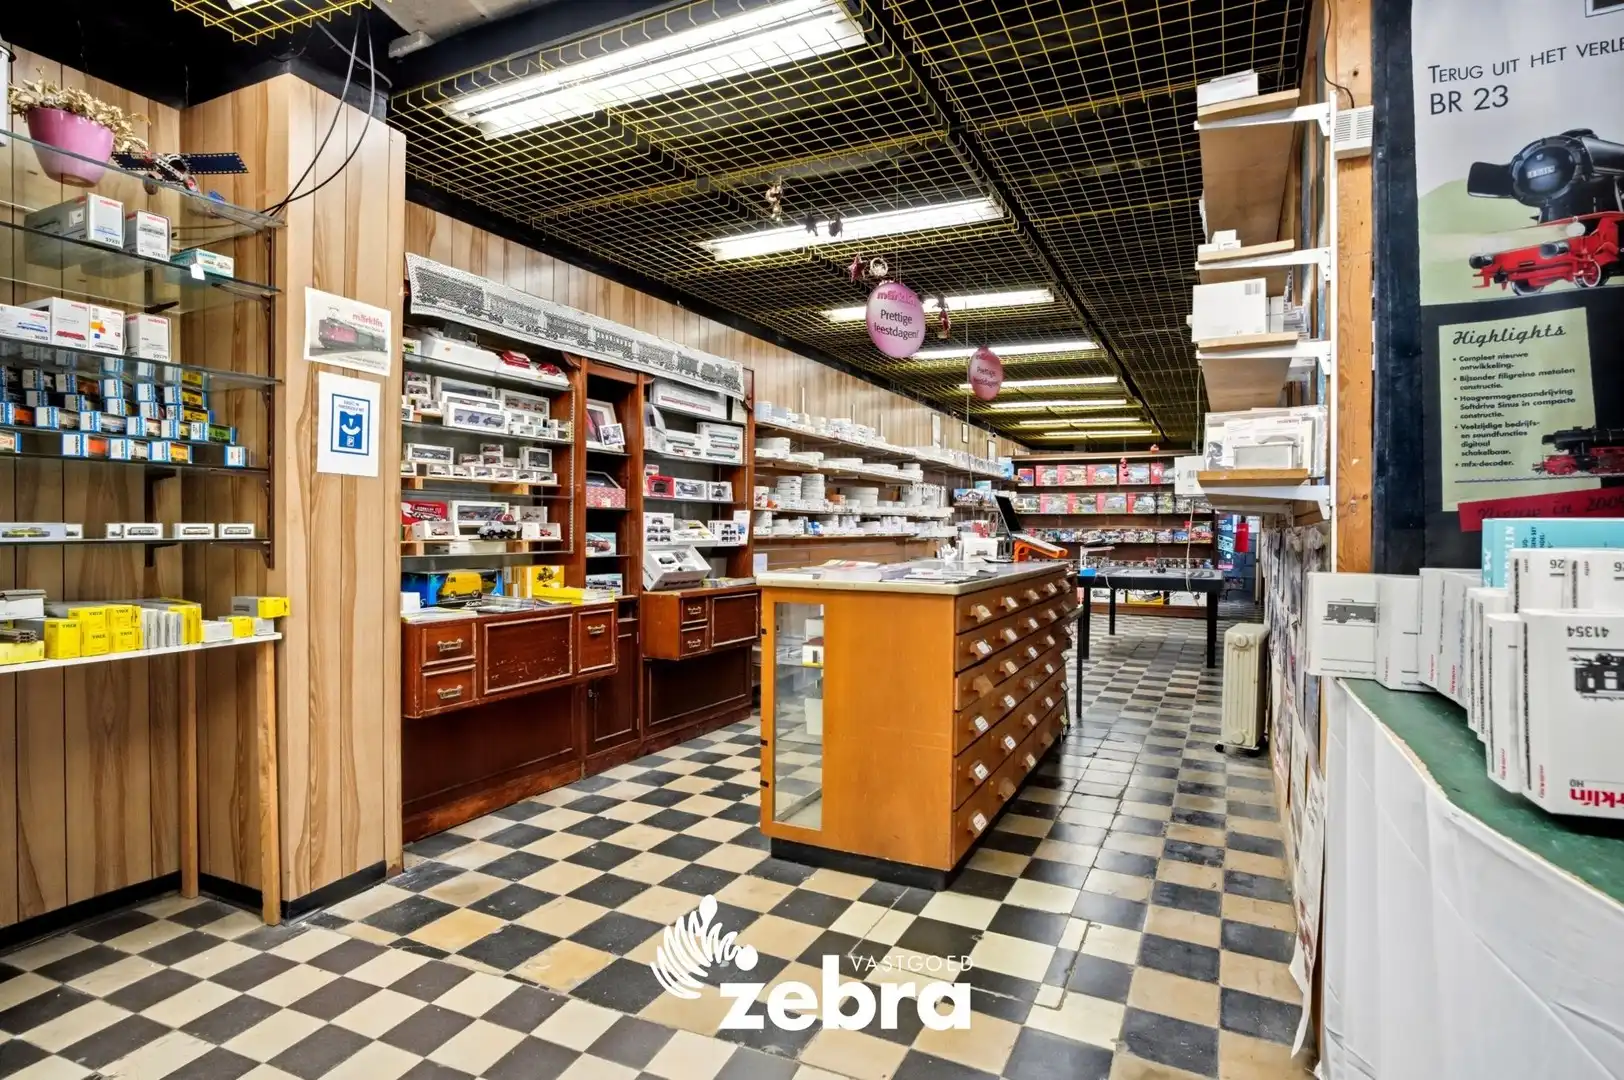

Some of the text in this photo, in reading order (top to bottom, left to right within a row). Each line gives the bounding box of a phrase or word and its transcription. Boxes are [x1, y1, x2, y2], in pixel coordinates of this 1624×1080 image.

[1492, 58, 1520, 76] UIT
[1530, 46, 1567, 68] HET
[1430, 85, 1509, 115] BR 23
[880, 309, 913, 327] Prettige
[1452, 324, 1566, 348] Highlights
[1459, 352, 1529, 362] Compleet nieuwe
[1459, 362, 1514, 371] ontwikkeling.
[1538, 367, 1576, 377] metalen
[1459, 382, 1504, 391] constructie.
[1460, 402, 1496, 411] Softdrive
[1497, 401, 1520, 409] Sinus
[1532, 397, 1576, 406] compacte
[1460, 411, 1505, 419] constructie.
[1460, 422, 1503, 431] Veelzijdige
[1472, 430, 1528, 439] soundfuncties
[1460, 440, 1491, 448] digitaal
[1461, 459, 1514, 468] mfx-decoder.
[1550, 559, 1564, 569] 26
[1566, 625, 1610, 638] 41354
